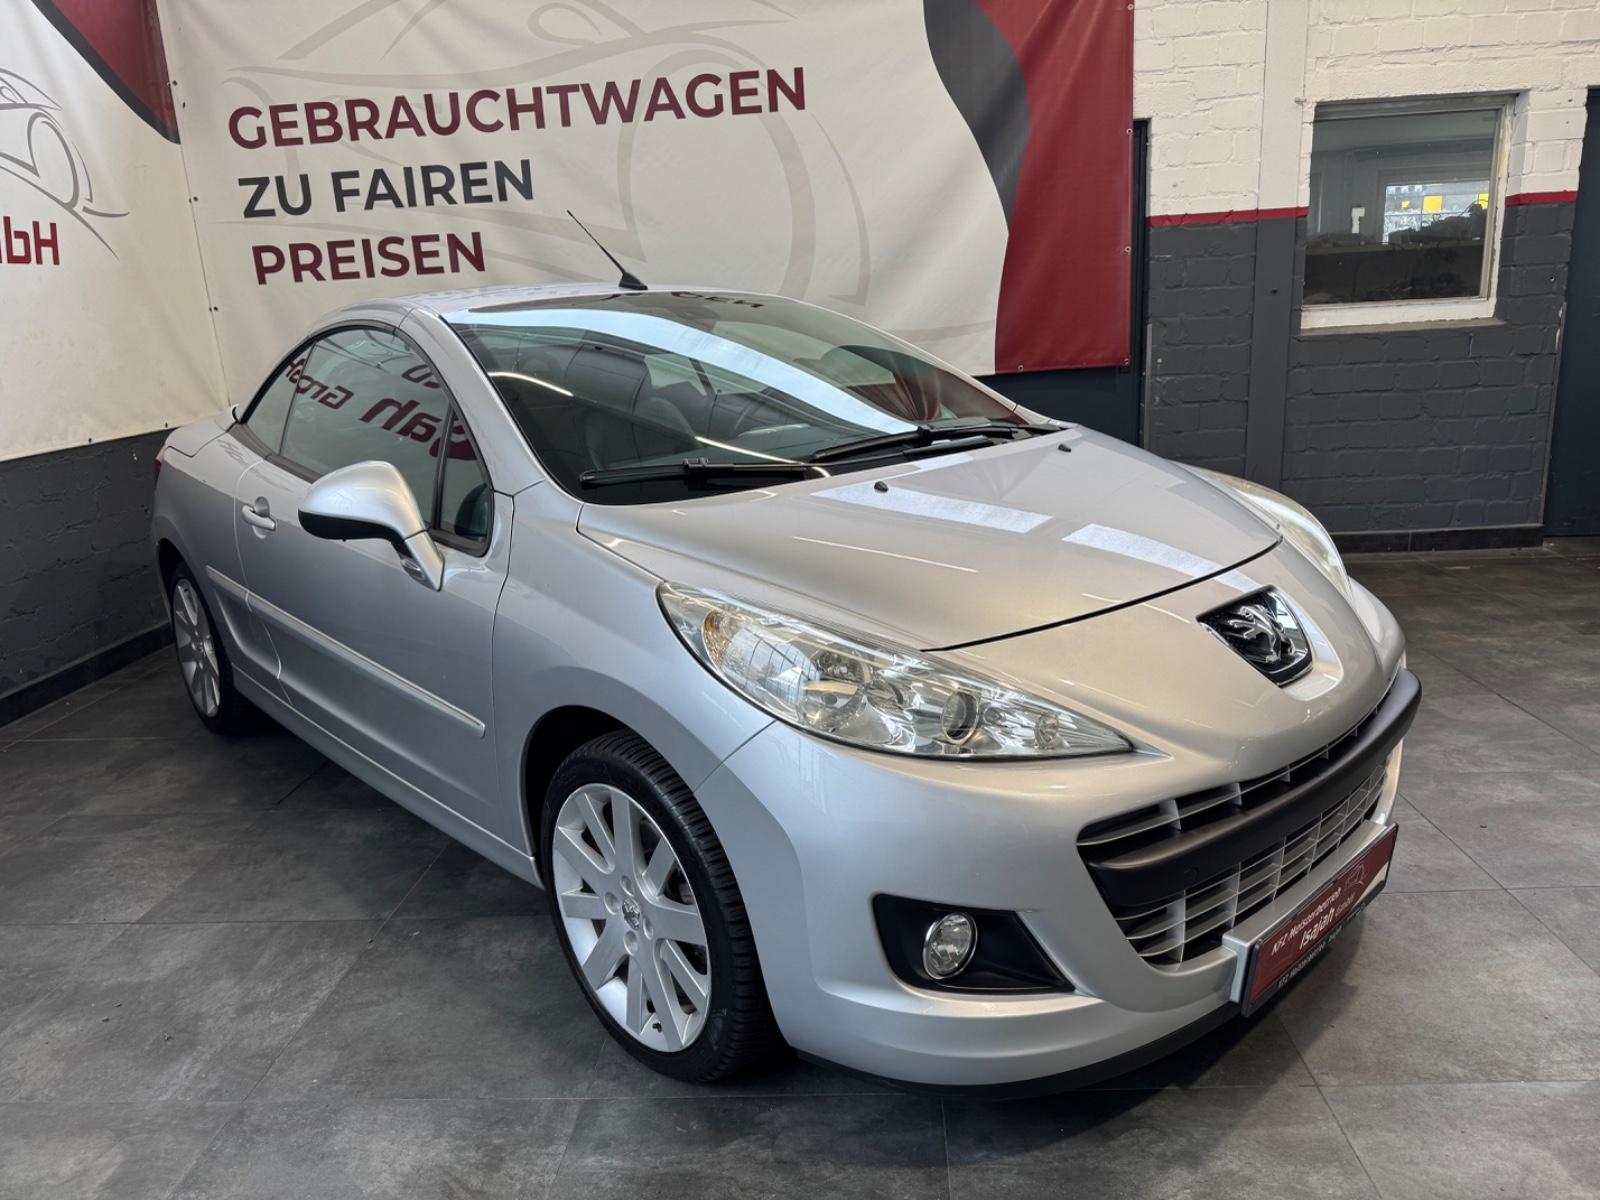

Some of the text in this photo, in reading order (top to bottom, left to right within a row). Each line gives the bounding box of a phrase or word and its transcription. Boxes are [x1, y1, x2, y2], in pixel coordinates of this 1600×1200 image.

[228, 66, 806, 150] GEBRAUCHTWAGEN
[237, 159, 534, 219] ZU FAIREN
[0, 215, 60, 266] bH
[251, 231, 486, 286] PREISEN
